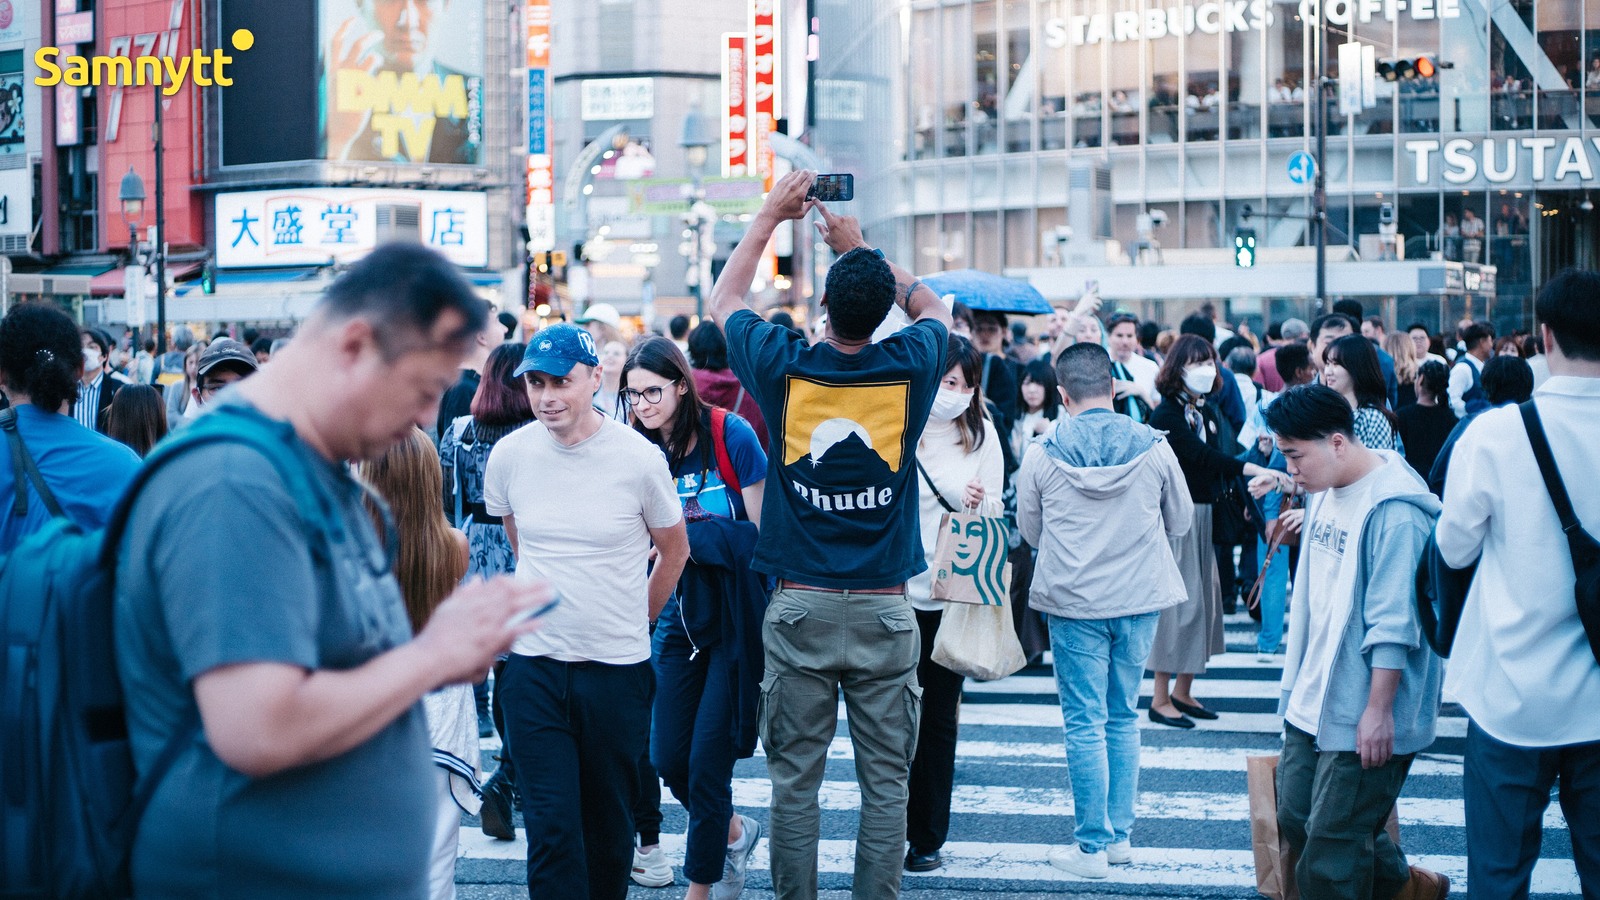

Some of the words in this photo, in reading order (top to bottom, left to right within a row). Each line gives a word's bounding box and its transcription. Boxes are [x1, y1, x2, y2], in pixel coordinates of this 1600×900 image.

[1045, 0, 1275, 48] STARBUCKS
[371, 112, 437, 161] TV
[1405, 137, 1600, 184] TSUTA
[230, 204, 465, 248] 大盛堂店
[792, 479, 893, 511] Rhude
